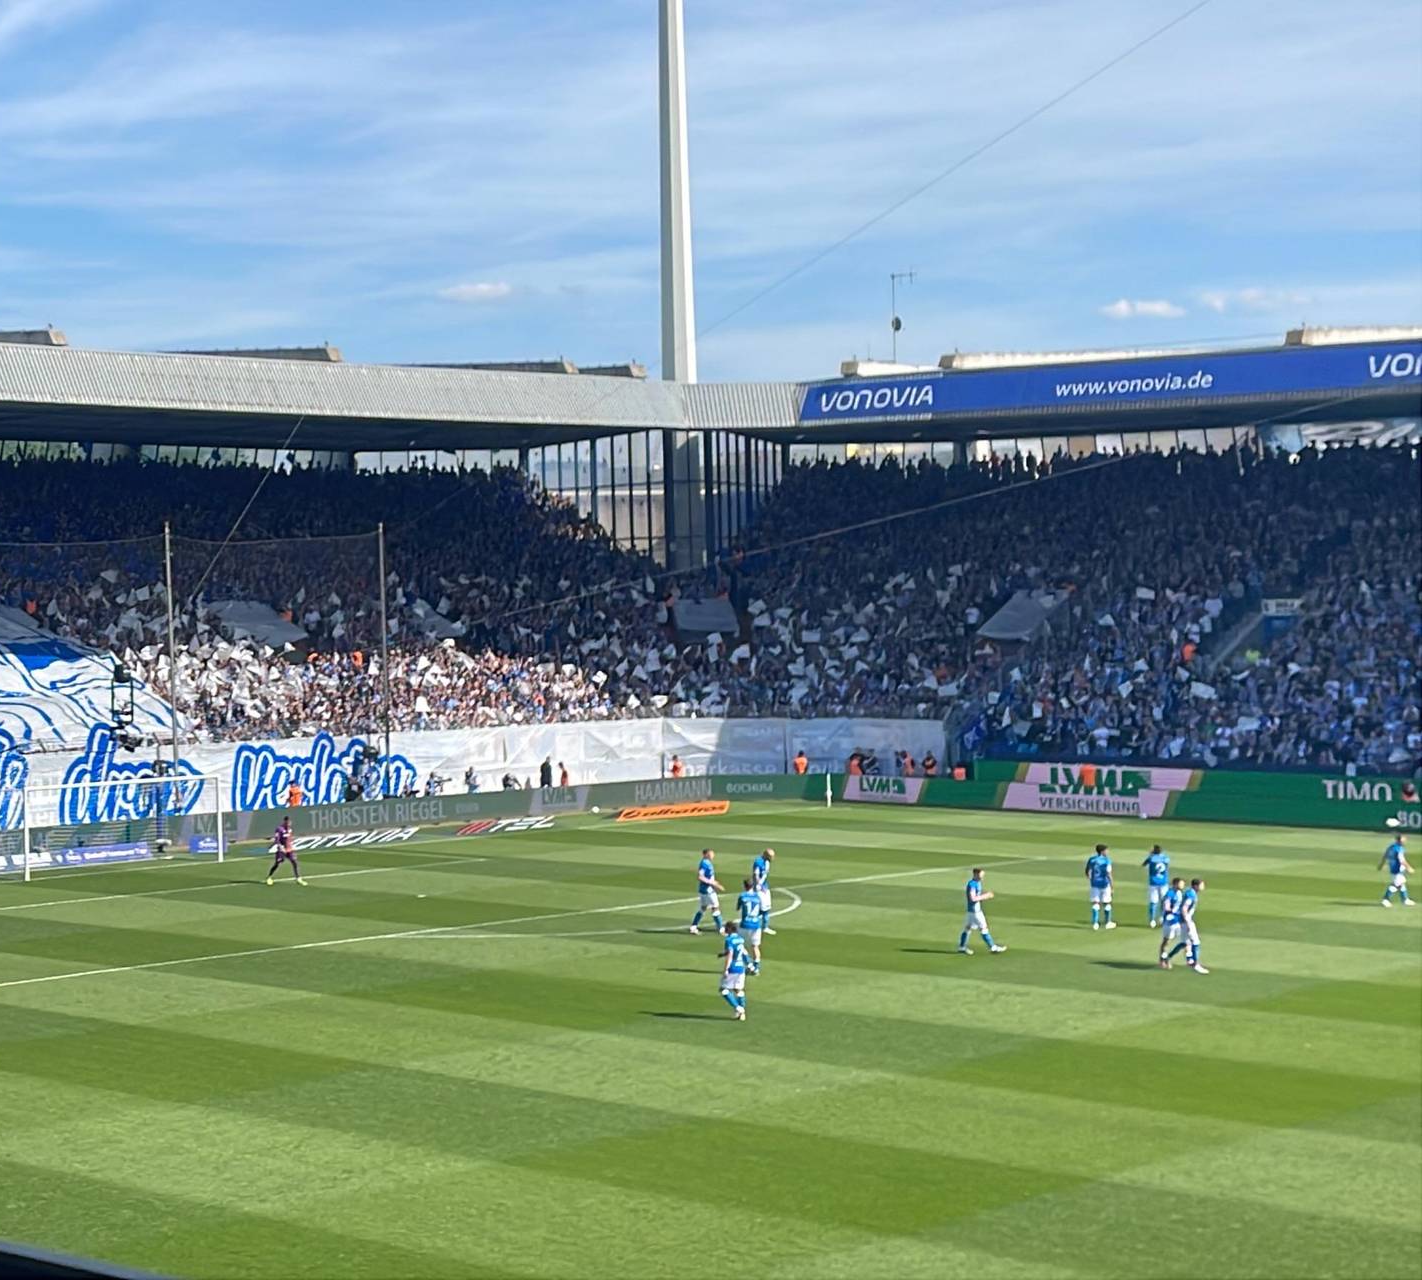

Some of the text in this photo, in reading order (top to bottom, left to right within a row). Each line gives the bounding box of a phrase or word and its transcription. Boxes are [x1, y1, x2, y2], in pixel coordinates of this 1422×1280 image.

[1055, 370, 1213, 397] www.vonovia.de
[820, 385, 934, 413] VONOVIA
[635, 779, 713, 801] HAARMANN
[1321, 779, 1393, 802] TIMO
[309, 804, 389, 830] THORSTEN
[396, 799, 447, 825] RIEGEL
[1039, 796, 1141, 814] VERSICHERUNG
